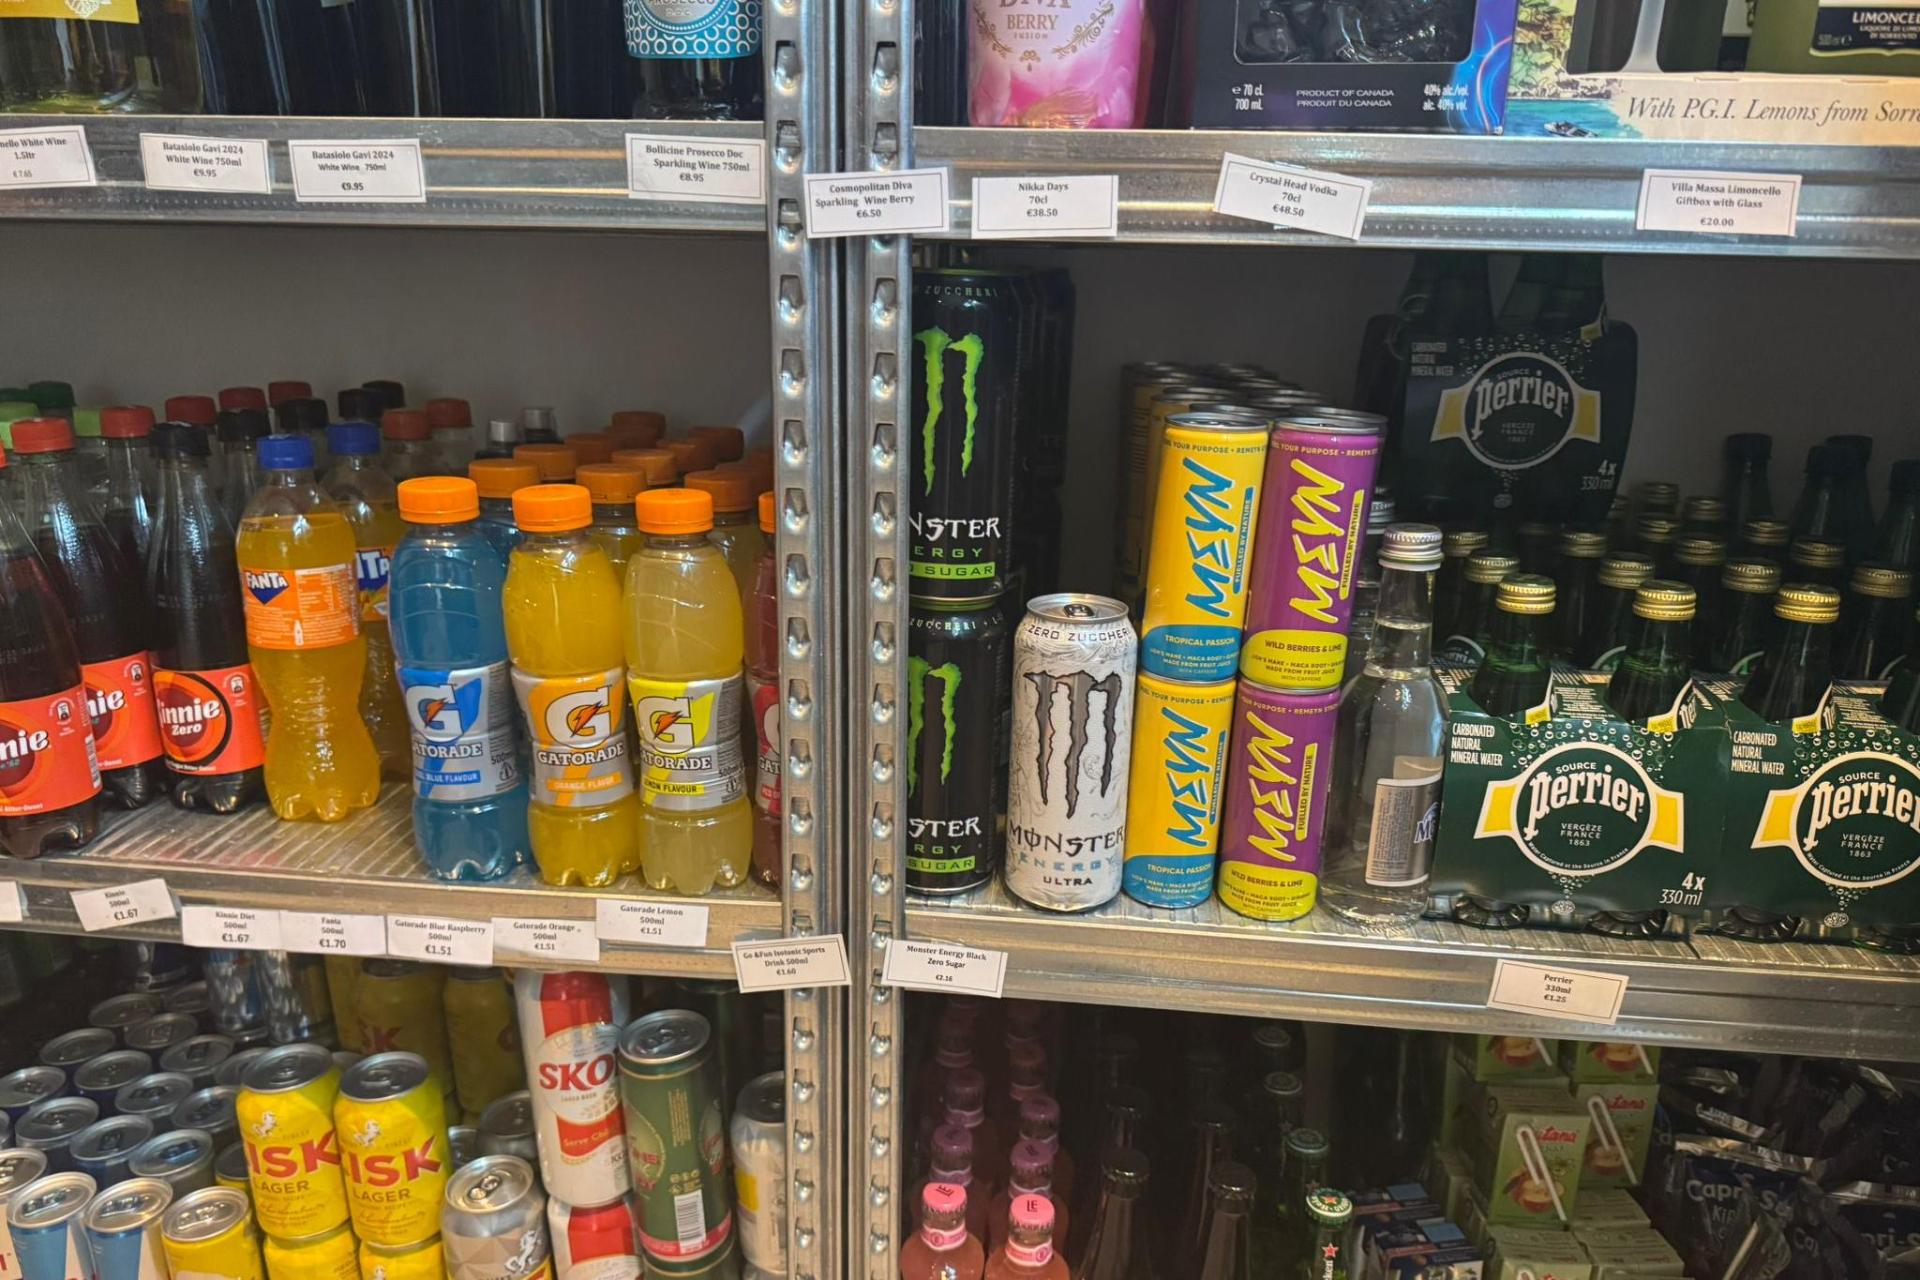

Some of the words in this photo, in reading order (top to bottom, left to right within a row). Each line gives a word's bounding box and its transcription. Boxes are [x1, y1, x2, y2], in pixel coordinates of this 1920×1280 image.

[1006, 14, 1058, 30] BERRY
[1014, 32, 1048, 40] FUSION
[1244, 84, 1254, 96] 70
[1296, 89, 1340, 98] PRODUCT
[1356, 90, 1394, 98] CANADA
[1424, 84, 1440, 96] 40%
[1235, 98, 1250, 110] 700
[1296, 100, 1336, 108] PRODUIT
[1354, 100, 1392, 108] CANADA
[1628, 98, 1676, 118] With
[1681, 98, 1736, 120] P.G.I.
[1744, 99, 1818, 120] Lemons
[1816, 101, 1868, 127] from
[20, 138, 44, 147] White
[45, 136, 67, 146] Wine
[162, 142, 200, 152] Batasiolo
[202, 144, 220, 153] Gavi
[222, 145, 244, 154] 2024
[646, 144, 684, 155] Bollicine
[686, 147, 725, 157] Prosecco
[727, 149, 743, 158] Doc
[166, 155, 190, 164] White
[192, 156, 214, 165] Wine
[216, 157, 242, 166] 750ml
[312, 151, 350, 160] Batasiolo
[352, 151, 371, 160] Gavi
[373, 151, 394, 160] 2024
[364, 164, 386, 172] 750ml
[654, 158, 696, 170] Sparkling
[698, 161, 720, 170] Wine
[723, 162, 750, 172] 750ml
[194, 169, 217, 178] €9.95
[680, 172, 704, 182] €8.95
[342, 182, 364, 190] €9.95
[829, 182, 890, 194] Cosmopolitan
[892, 181, 912, 190] Diva
[1018, 182, 1044, 192] Nikka
[1046, 182, 1069, 192] Days
[1250, 172, 1282, 186] Crystal
[1283, 180, 1308, 191] Head
[1308, 183, 1338, 197] Vodka
[1672, 182, 1693, 192] Villa
[1696, 183, 1725, 194] Massa
[1728, 184, 1782, 196] Limoncello
[816, 197, 859, 208] Sparkling
[864, 196, 887, 206] Wine
[889, 195, 915, 204] Berry
[1028, 196, 1048, 204] 70cl
[1282, 192, 1302, 203] 70cl
[1676, 196, 1710, 207] Giftbox
[1713, 198, 1734, 208] with
[1737, 198, 1763, 208] Glass
[856, 208, 882, 218] €6.50
[1026, 208, 1058, 217] €38.50
[1272, 204, 1304, 217] €48.50
[1700, 217, 1734, 226] €20.00
[1192, 444, 1229, 454] PURPOSE
[1301, 446, 1339, 456] PURPOSE
[914, 546, 982, 558] ERGY
[924, 565, 992, 576] SUGAR
[1026, 624, 1060, 640] ZERO
[1068, 626, 1132, 642] ZUCCHERI
[1165, 634, 1204, 646] TROPICAL
[1206, 636, 1235, 646] PASSION
[1264, 640, 1285, 650] WILD
[1286, 644, 1320, 653] BERRIES
[1170, 695, 1204, 704] PURPOSE
[1254, 702, 1286, 714] PURPOSE
[545, 684, 612, 749] G
[172, 722, 202, 736] Zero
[637, 696, 695, 754] G
[1452, 722, 1496, 737] CARBONATED
[1452, 736, 1482, 750] NATURAL
[1733, 730, 1777, 746] CARBONATED
[537, 744, 625, 766] GATORADE
[1450, 750, 1480, 765] MINERAL
[1480, 752, 1503, 766] WATER
[1732, 745, 1763, 760] NATURAL
[1555, 762, 1597, 776] SOURCE
[1731, 760, 1760, 774] MINERAL
[1762, 762, 1785, 776] WATER
[1838, 772, 1880, 784] SOURCE
[663, 783, 698, 794] FLAVOUR
[1523, 765, 1646, 840] perrier
[908, 816, 982, 838] STER
[1560, 822, 1604, 832] VERGÈZE
[1560, 830, 1600, 839] FRANCE
[1568, 838, 1590, 847] 1863
[1841, 840, 1884, 851] FRANCE
[914, 843, 962, 854] RGY
[1849, 850, 1872, 858] 1863
[908, 859, 972, 870] SUGAR
[1018, 851, 1120, 872] ENERGY
[1148, 864, 1185, 875] TROPICAL
[1042, 876, 1092, 886] ULTRA
[1247, 876, 1278, 887] BERRIES
[1287, 879, 1304, 888] LIME
[1682, 872, 1706, 891] 4x
[109, 900, 130, 908] 500ml
[114, 908, 138, 920] €1.67
[216, 910, 239, 920] Kinnie
[240, 912, 256, 920] Diet
[620, 904, 656, 914] Gatorade
[658, 907, 684, 916] Lemon
[224, 922, 246, 930] 500ml
[321, 917, 342, 926] Fanta
[640, 916, 664, 925] 500ml
[322, 927, 344, 935] 500ml
[394, 920, 428, 930] Gatorade
[429, 922, 446, 930] Blue
[448, 924, 486, 935] Raspberry
[513, 922, 548, 930] Gatorade
[549, 923, 576, 932] Orange
[640, 927, 662, 935] €1.51
[222, 932, 250, 944] €1.67
[428, 932, 452, 942] 500ml
[532, 932, 557, 941] 500ml
[319, 938, 346, 948] €1.70
[534, 942, 555, 951] €1.51
[424, 944, 452, 956] €1.51
[774, 948, 802, 958] Isotonic
[803, 946, 826, 956] Sports
[906, 944, 938, 955] Monster
[938, 949, 965, 959] Energy
[966, 952, 987, 961] Black
[764, 960, 785, 968] Drink
[786, 957, 808, 965] 500ml
[928, 958, 944, 966] Zero
[944, 960, 966, 969] Sugar
[1544, 973, 1574, 984] Perrier
[1545, 984, 1572, 994] 330ml
[1544, 994, 1567, 1004] €1.25
[538, 1054, 615, 1092] SKO
[353, 1187, 411, 1203] LAGER
[1026, 1200, 1038, 1212] LE
